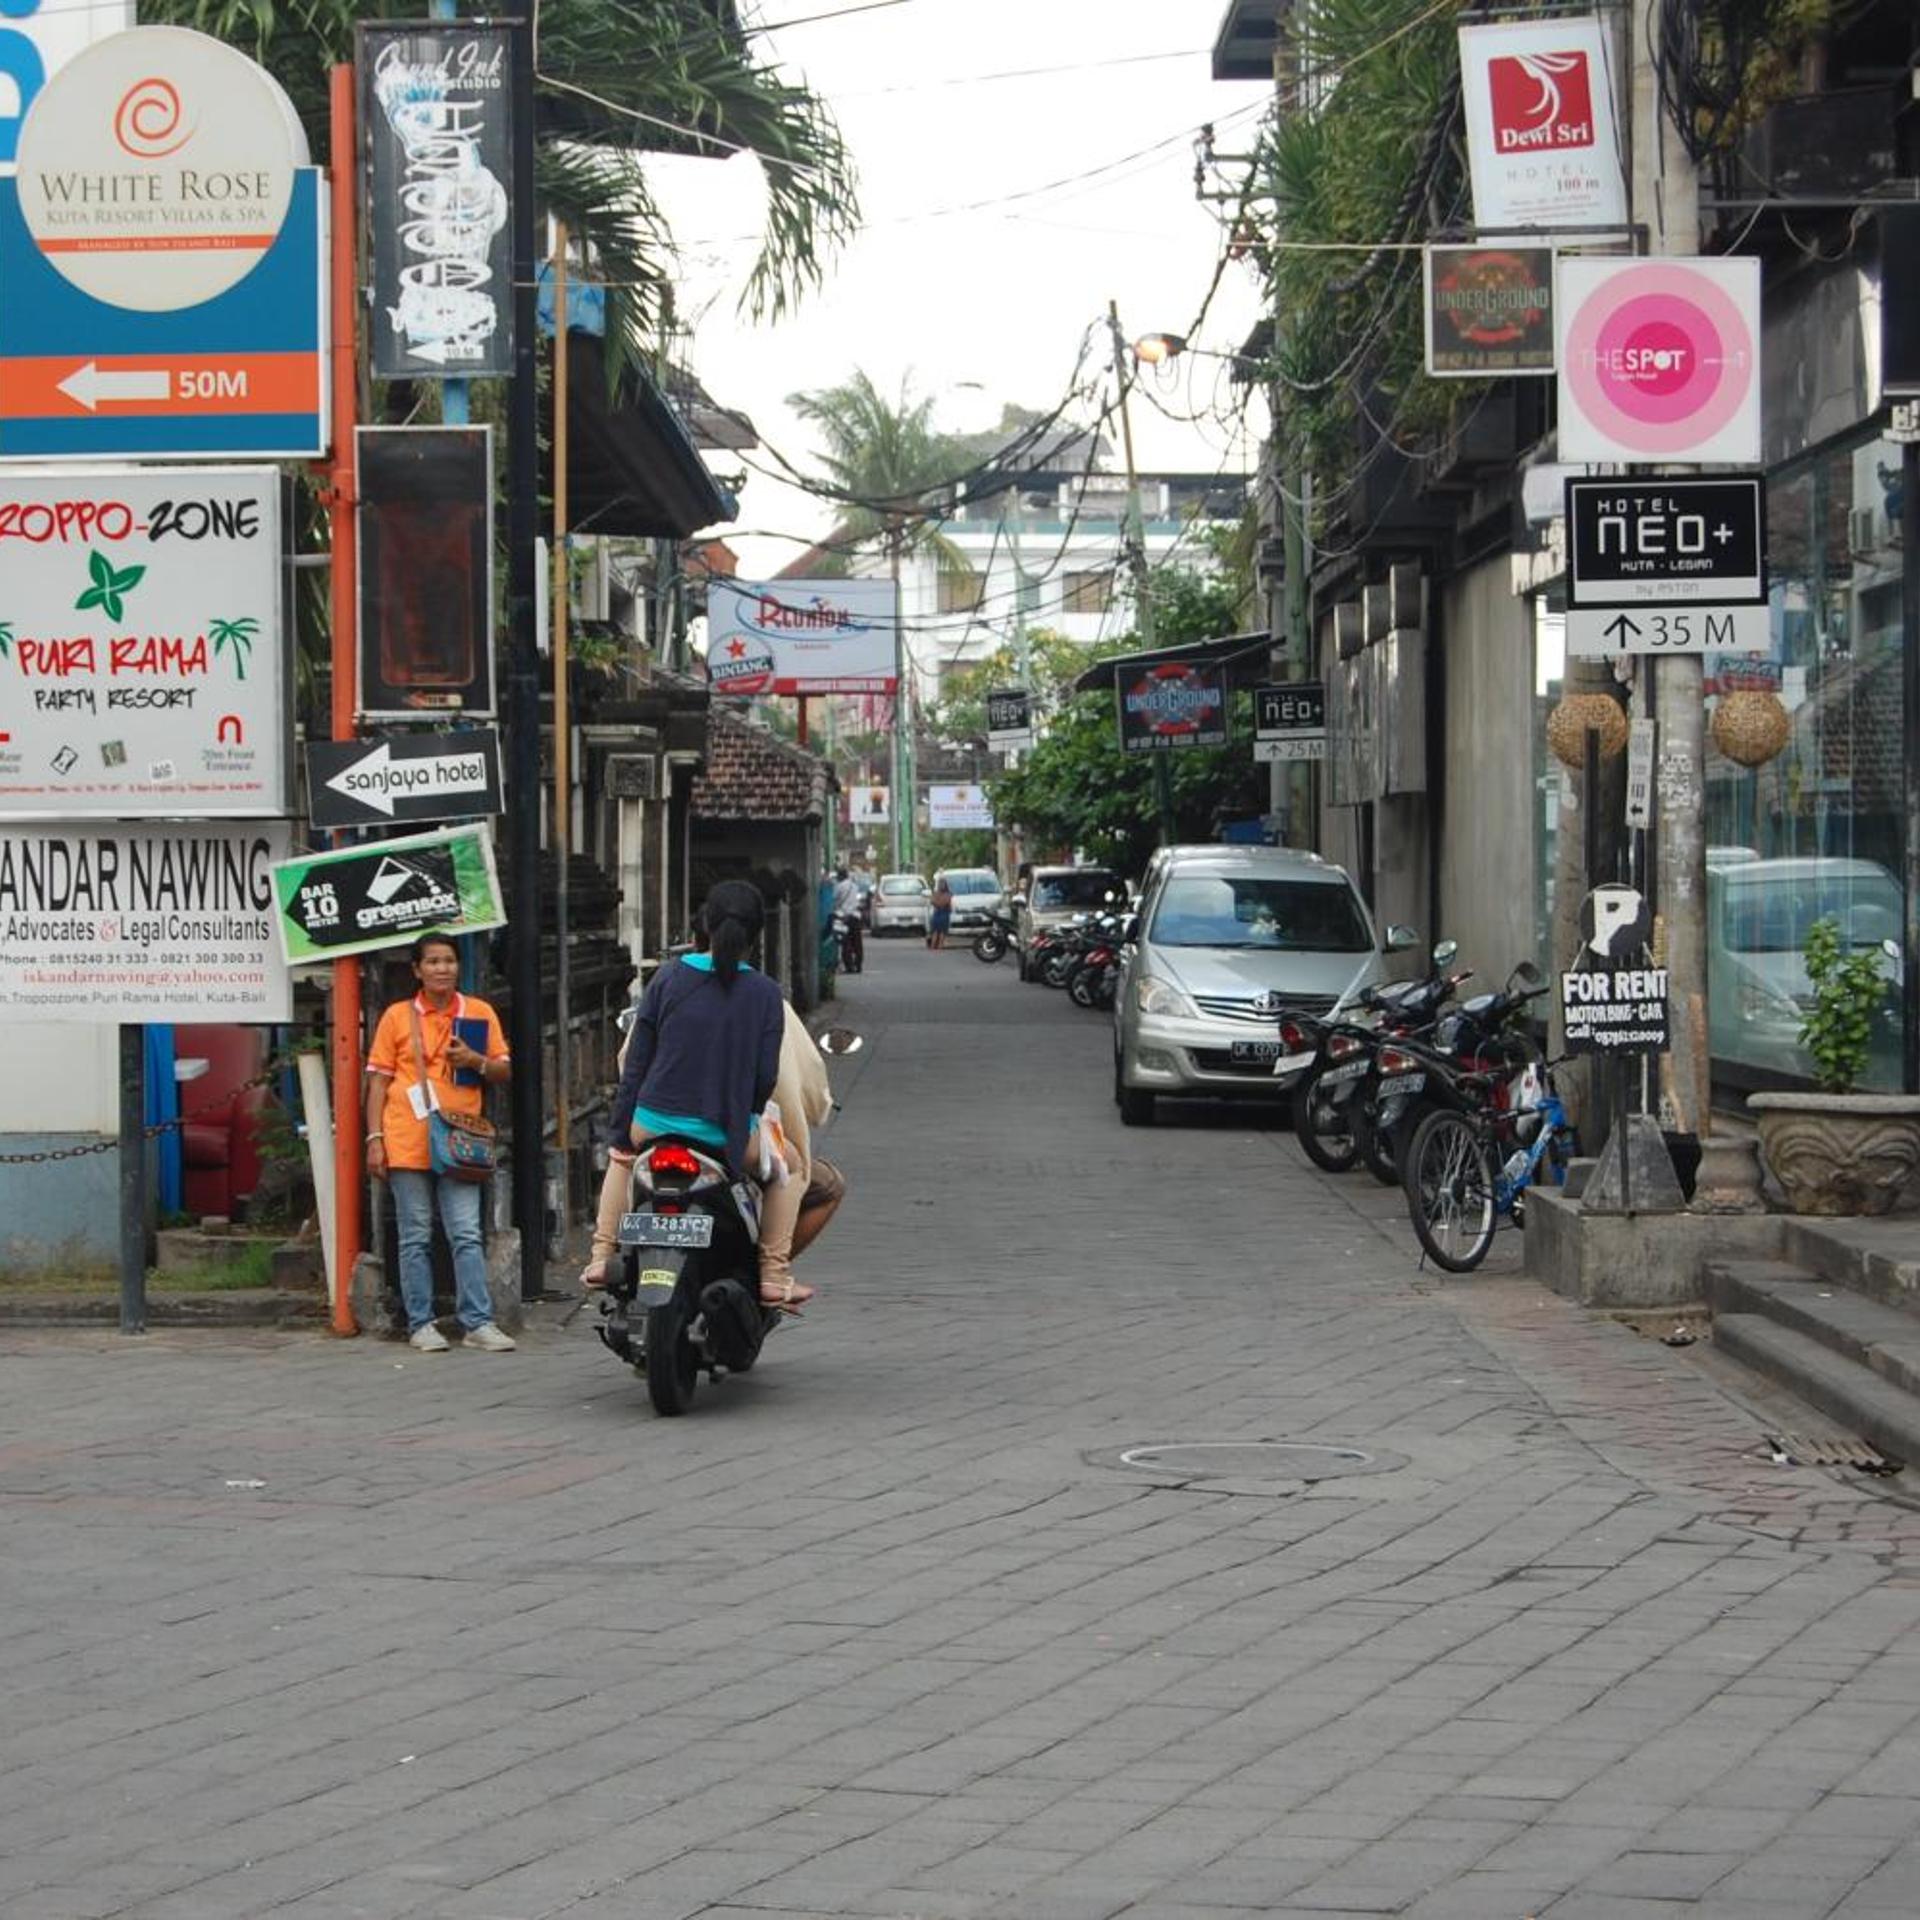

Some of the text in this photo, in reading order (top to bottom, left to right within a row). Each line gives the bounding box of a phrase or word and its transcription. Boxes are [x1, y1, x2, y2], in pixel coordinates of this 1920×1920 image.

[1502, 122, 1589, 147] Dewi Sri
[40, 171, 271, 201] WHITE ROSE
[46, 207, 266, 225] KUTA RESORT VILLAS & SPA
[1436, 286, 1549, 313] UNDERGROUND
[177, 370, 248, 400] 50M
[1598, 499, 1680, 514] HOTEL
[1669, 558, 1713, 571] LEGIAN
[1650, 614, 1736, 646] 35 M
[17, 634, 208, 677] PURI RAMA
[34, 687, 197, 716] PARTY RESORT
[1126, 687, 1220, 713] UNDERGROUND
[345, 757, 485, 795] sanjaya hotel
[0, 838, 273, 912] ANDAR NAWING
[301, 883, 335, 901] BAR
[303, 895, 339, 919] 10
[120, 915, 166, 947] Legal
[168, 916, 270, 941] Consultants
[305, 916, 340, 928] METER
[125, 953, 149, 964] 333
[247, 953, 264, 963] 33
[23, 969, 265, 987] iskandarnawing@yahoo.com
[1563, 970, 1668, 1003] FOR RENT
[206, 991, 266, 1002] Kuta-Bali
